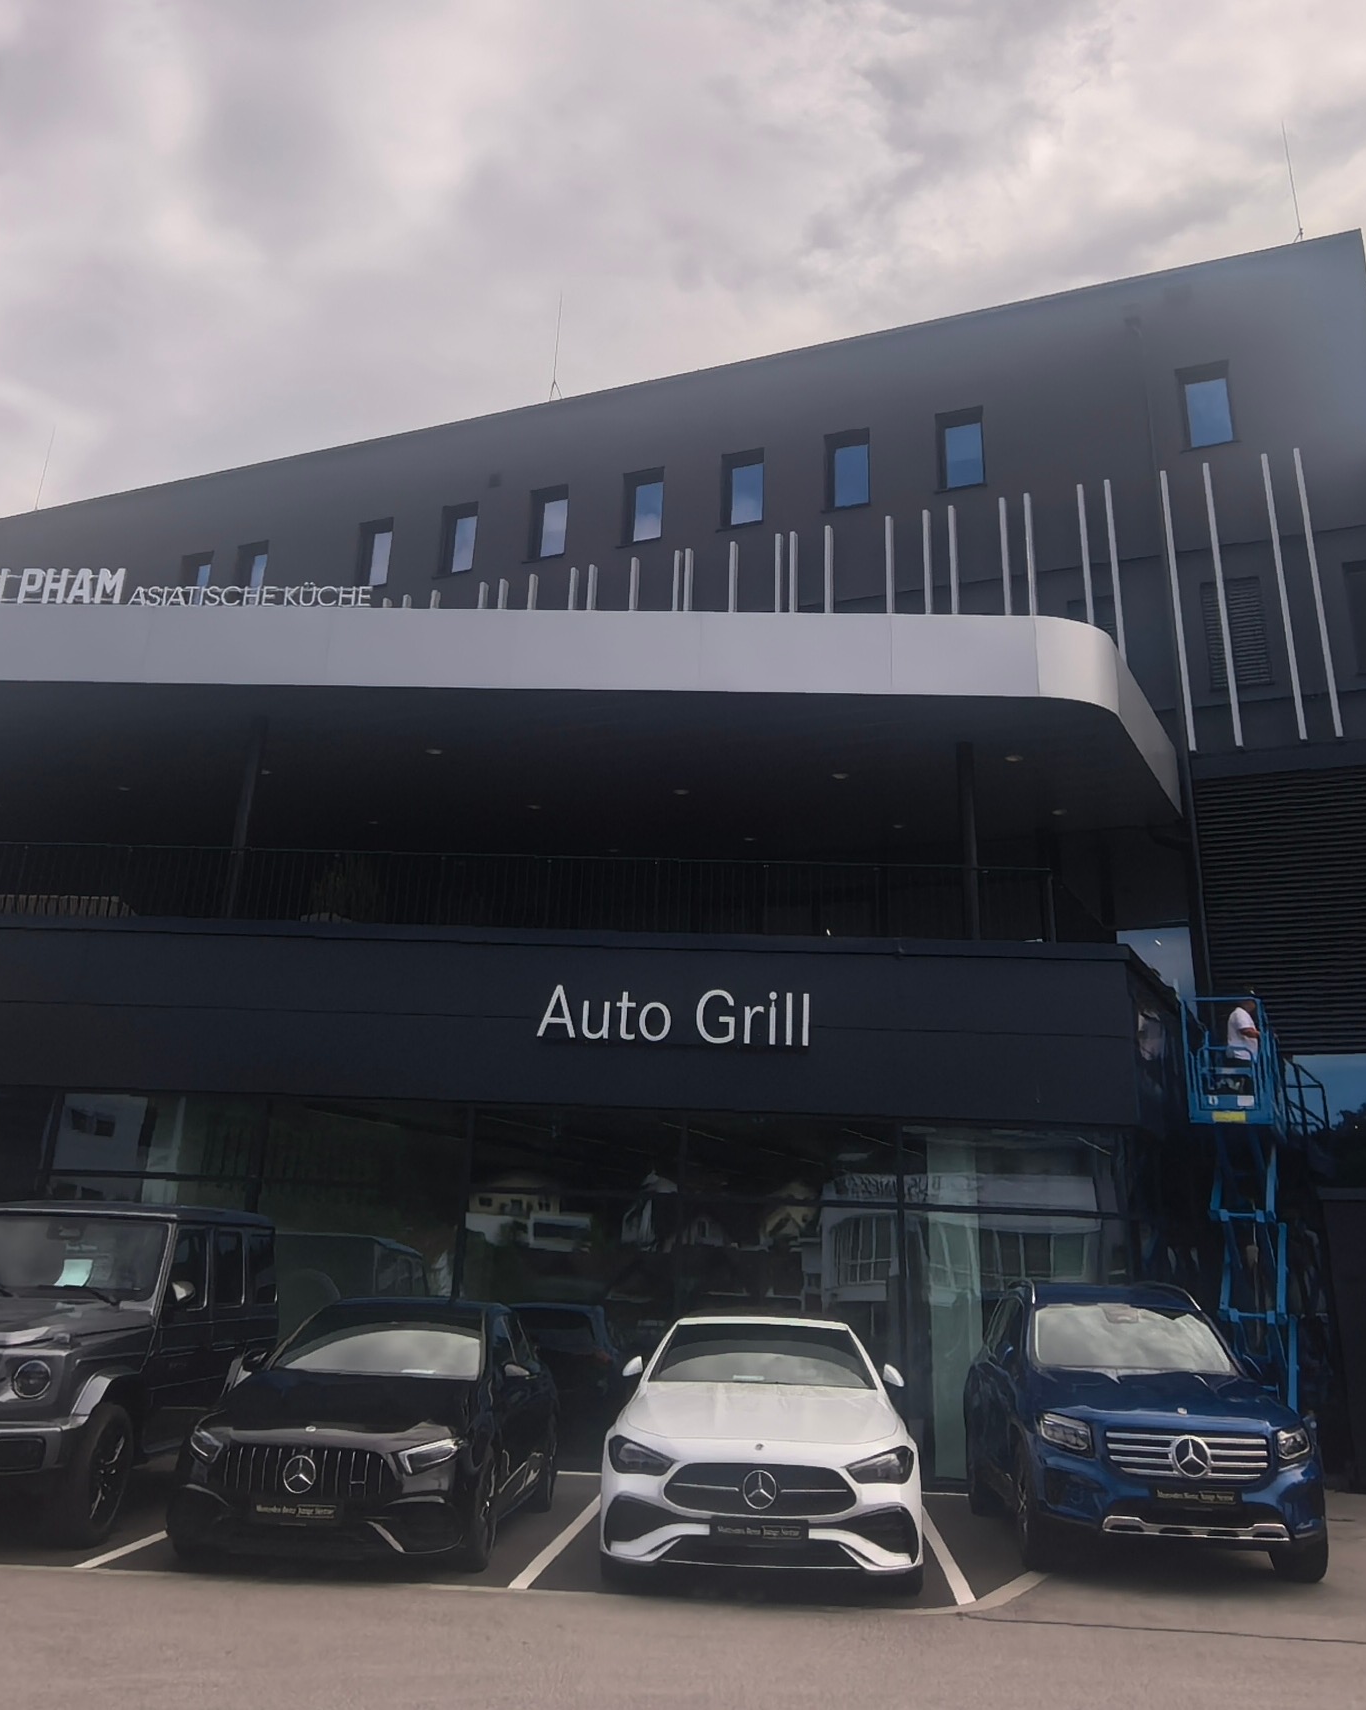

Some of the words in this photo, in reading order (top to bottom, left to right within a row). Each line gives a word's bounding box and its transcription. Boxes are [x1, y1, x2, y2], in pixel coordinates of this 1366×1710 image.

[17, 567, 127, 606] PHAM
[127, 585, 278, 607] ASIATISCHE
[283, 581, 374, 607] KÜCHE
[536, 984, 672, 1042] Auto
[695, 989, 810, 1047] Grill
